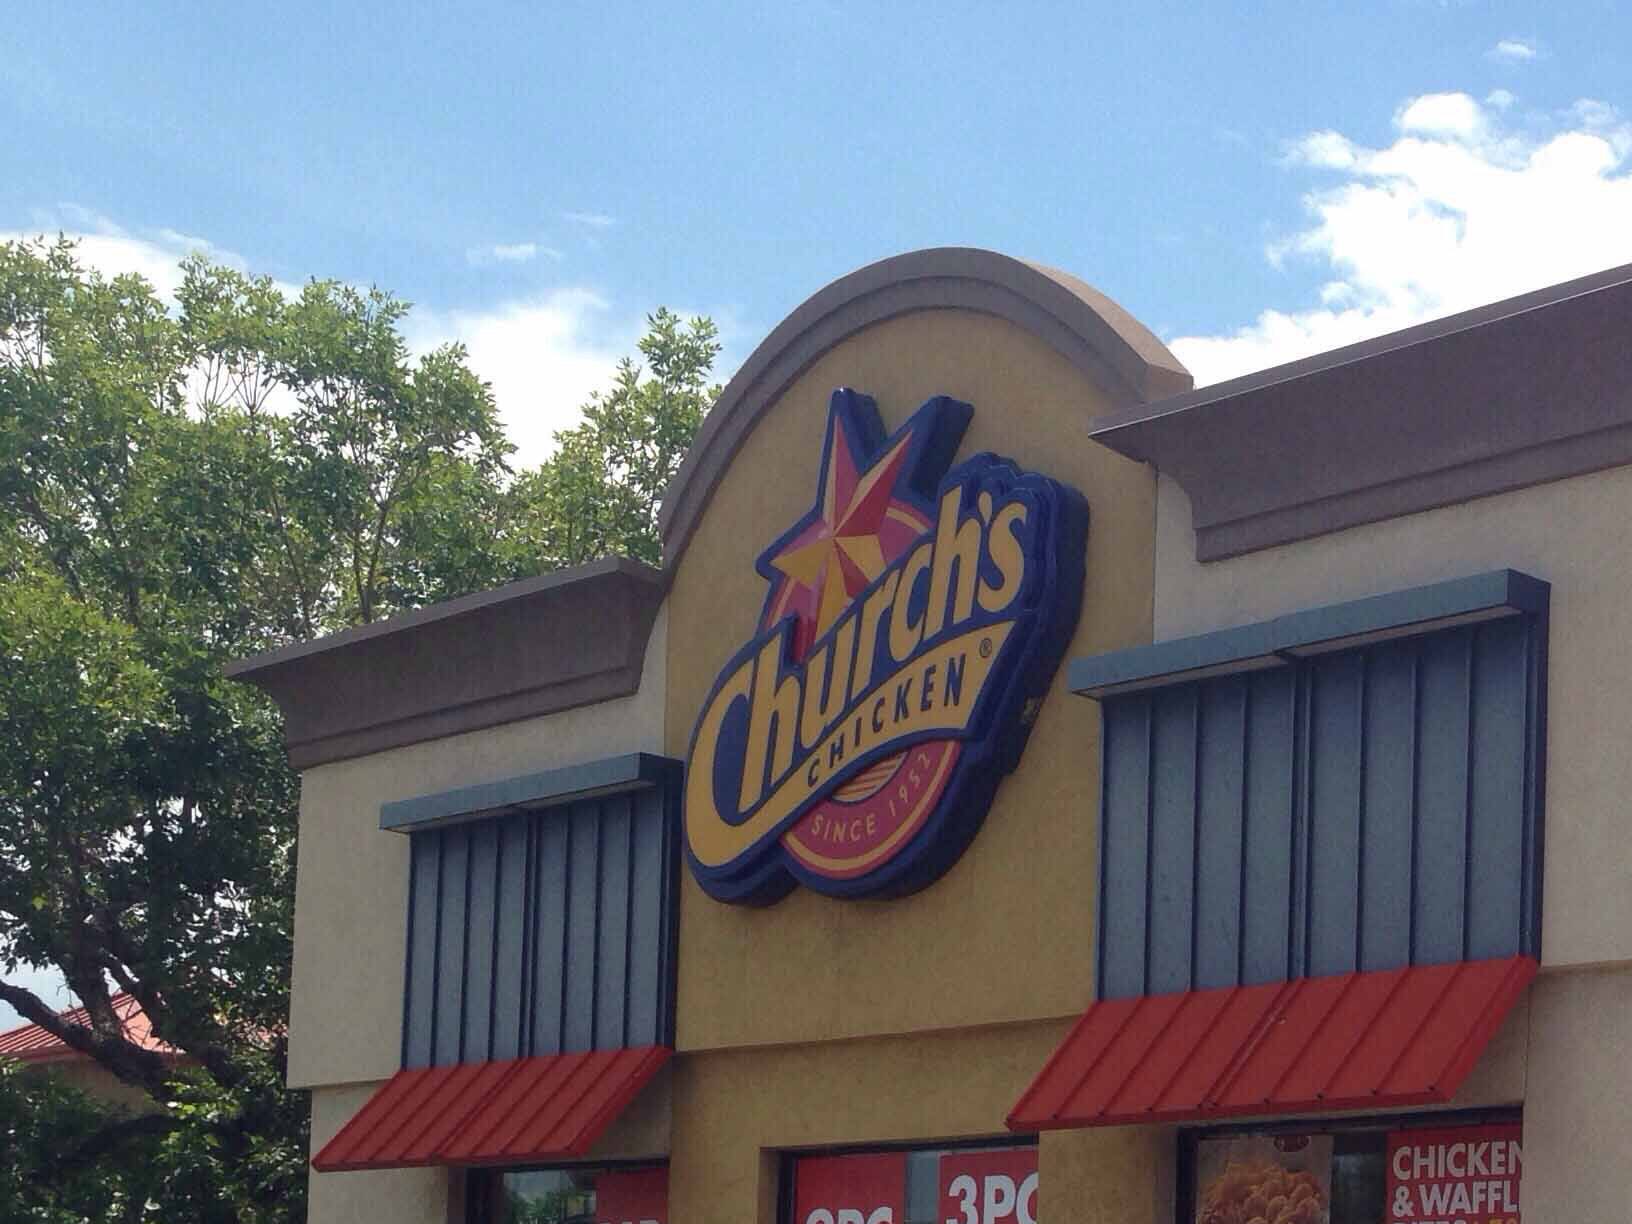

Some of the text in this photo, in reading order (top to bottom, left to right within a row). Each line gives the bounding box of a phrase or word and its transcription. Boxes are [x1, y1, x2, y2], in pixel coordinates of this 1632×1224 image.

[684, 484, 1028, 868] Church's
[807, 653, 967, 788] CHICKEN
[811, 751, 932, 842] SINCE 1952
[1392, 1180, 1520, 1218] & WAFFL
